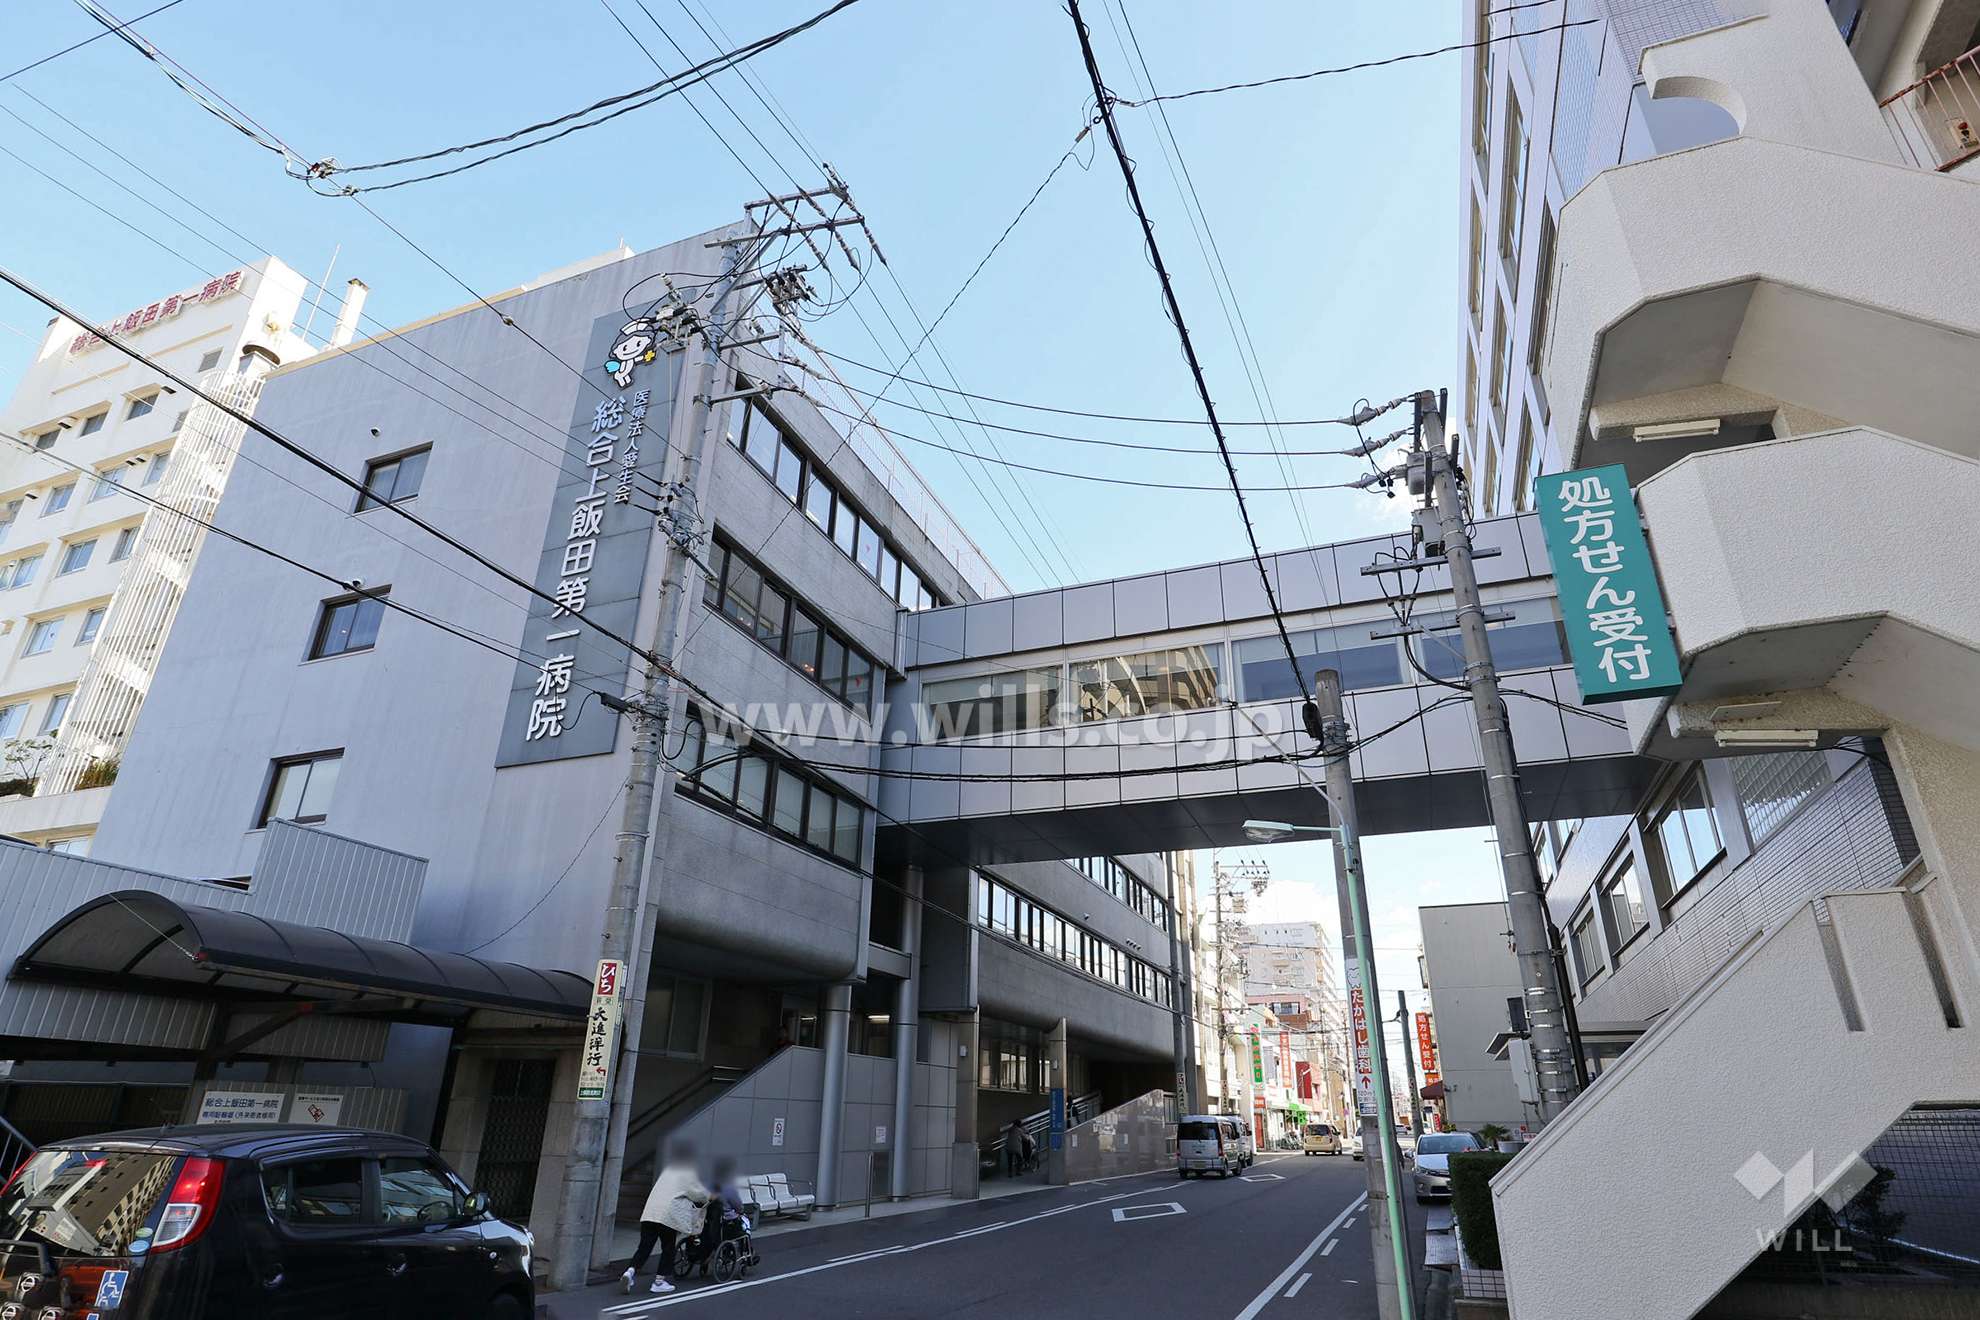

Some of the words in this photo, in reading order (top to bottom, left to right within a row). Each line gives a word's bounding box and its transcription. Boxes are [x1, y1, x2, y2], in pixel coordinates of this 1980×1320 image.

[614, 389, 651, 505] 医療法人愛生会
[525, 396, 626, 742] 総合上飯田第一病院
[1558, 476, 1652, 683] 処方せん受付
[1351, 990, 1371, 1073] たかはし歯科
